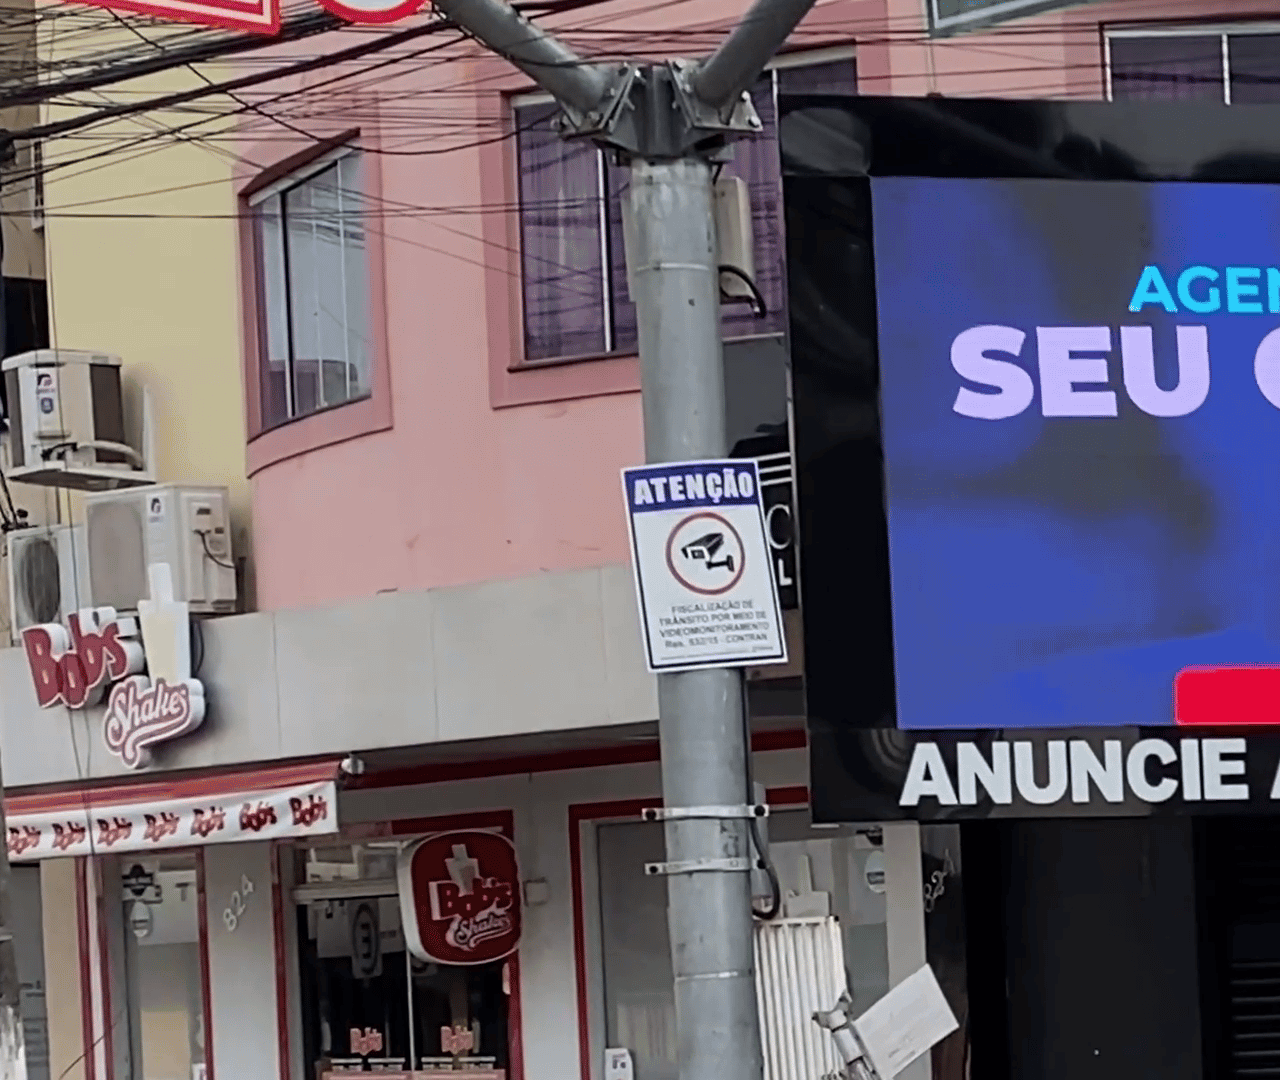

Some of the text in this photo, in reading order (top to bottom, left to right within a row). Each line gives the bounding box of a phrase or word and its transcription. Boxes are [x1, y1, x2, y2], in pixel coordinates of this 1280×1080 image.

[949, 323, 1211, 421] SEU
[633, 468, 755, 505] ATENÇÃO
[21, 607, 132, 709] Bob's
[899, 737, 1250, 806] ANUNCIE
[222, 874, 254, 932] 824
